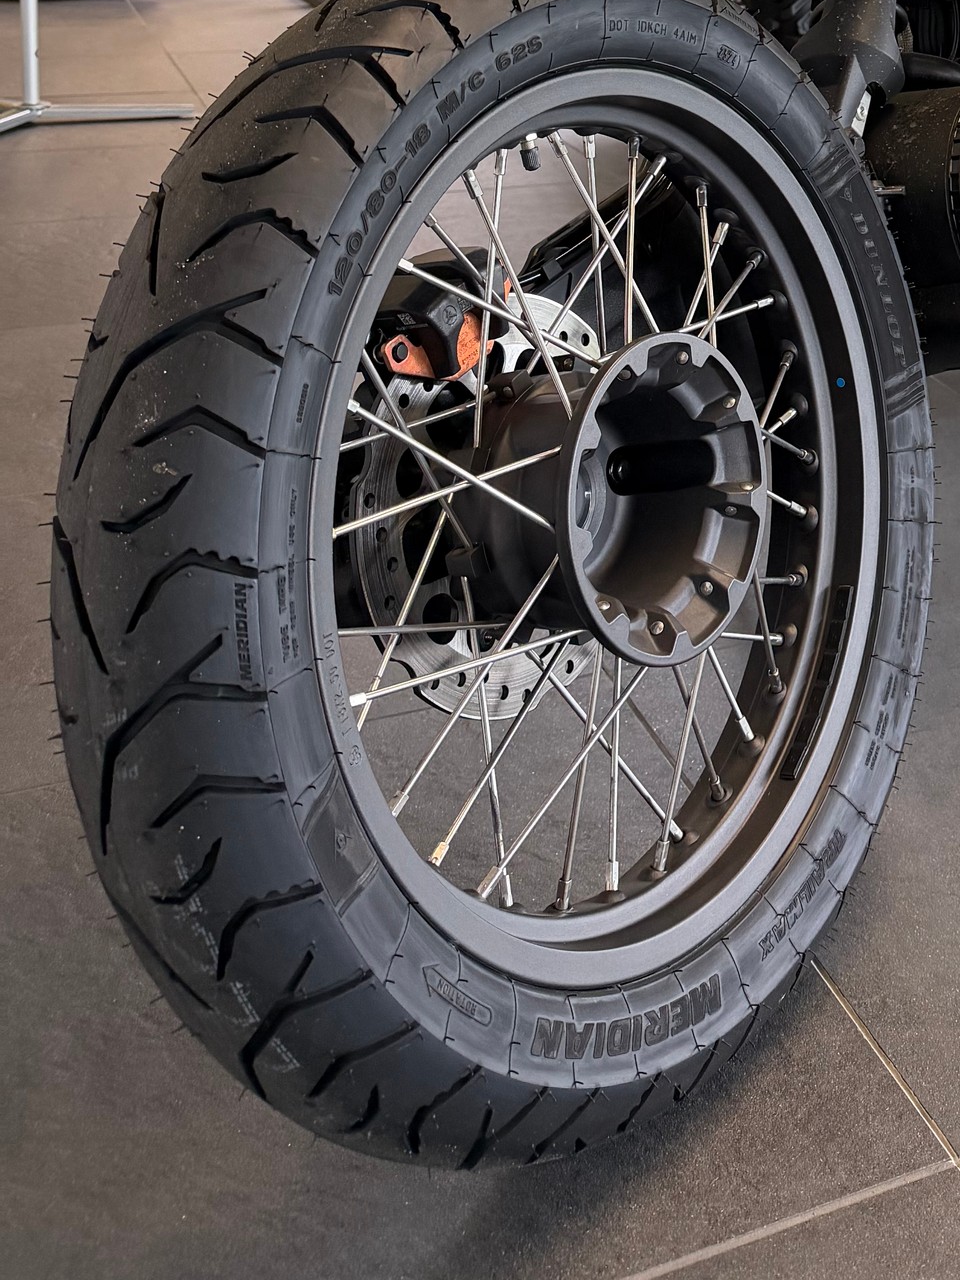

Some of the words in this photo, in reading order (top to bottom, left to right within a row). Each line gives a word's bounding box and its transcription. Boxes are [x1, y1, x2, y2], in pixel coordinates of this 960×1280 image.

[608, 19, 629, 32] DOT
[327, 123, 432, 297] 120/80-18
[435, 71, 485, 124] M/C
[495, 35, 543, 72] 62S
[850, 212, 907, 368] DUNLOP
[233, 582, 252, 682] MERIDIAN
[758, 828, 847, 961] TRAILMAX
[436, 977, 478, 1017] ROTATION
[531, 974, 721, 1061] MERIDIAN
